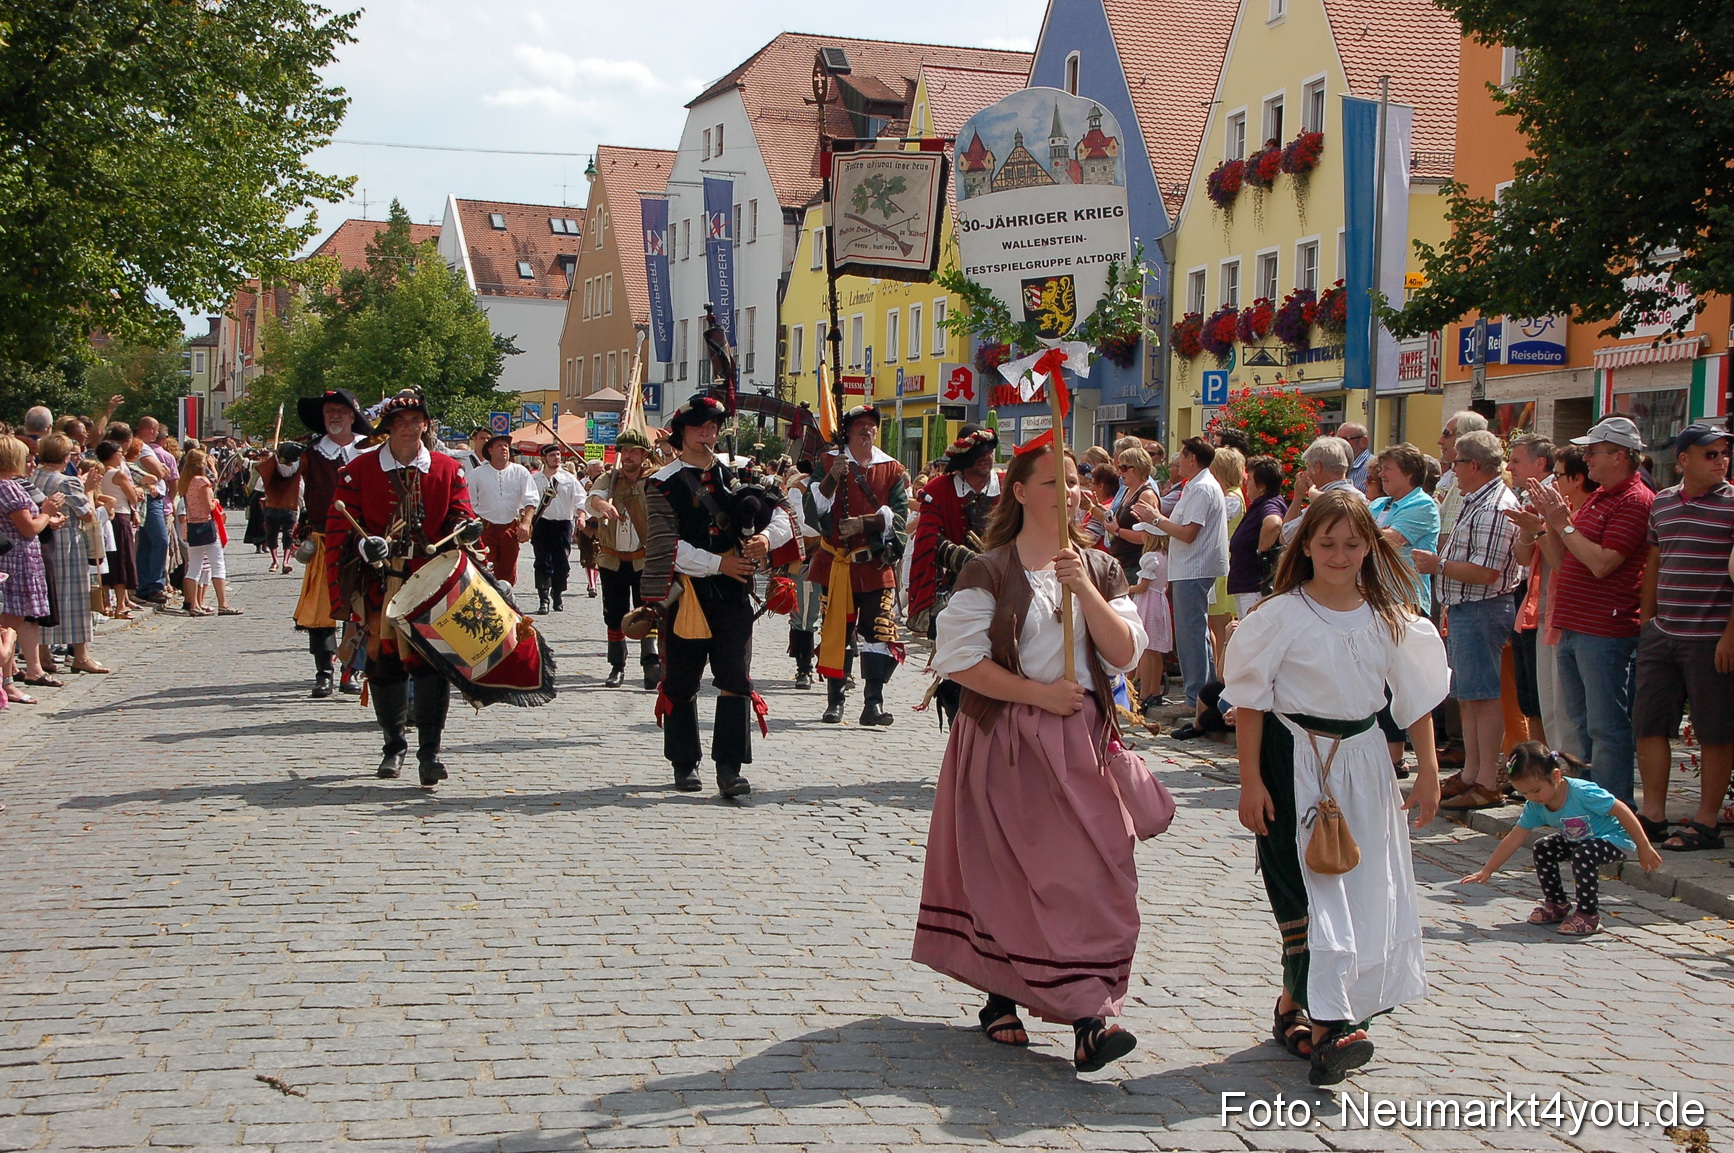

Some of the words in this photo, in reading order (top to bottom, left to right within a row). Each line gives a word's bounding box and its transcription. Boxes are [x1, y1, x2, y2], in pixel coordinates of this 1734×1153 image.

[962, 211, 1068, 233] 30-JÄHRIGER
[1074, 205, 1124, 221] KRIEG
[1002, 234, 1087, 250] WALLENSTEIN-
[965, 257, 1071, 275] FESTSPIELGRUPPE
[1076, 252, 1127, 265] ALTDORF
[717, 245, 729, 307] RUPPERT
[849, 288, 874, 307] Lehmeier
[721, 309, 730, 333] K&L
[1511, 350, 1562, 361] Reisebüro
[1207, 374, 1223, 402] P
